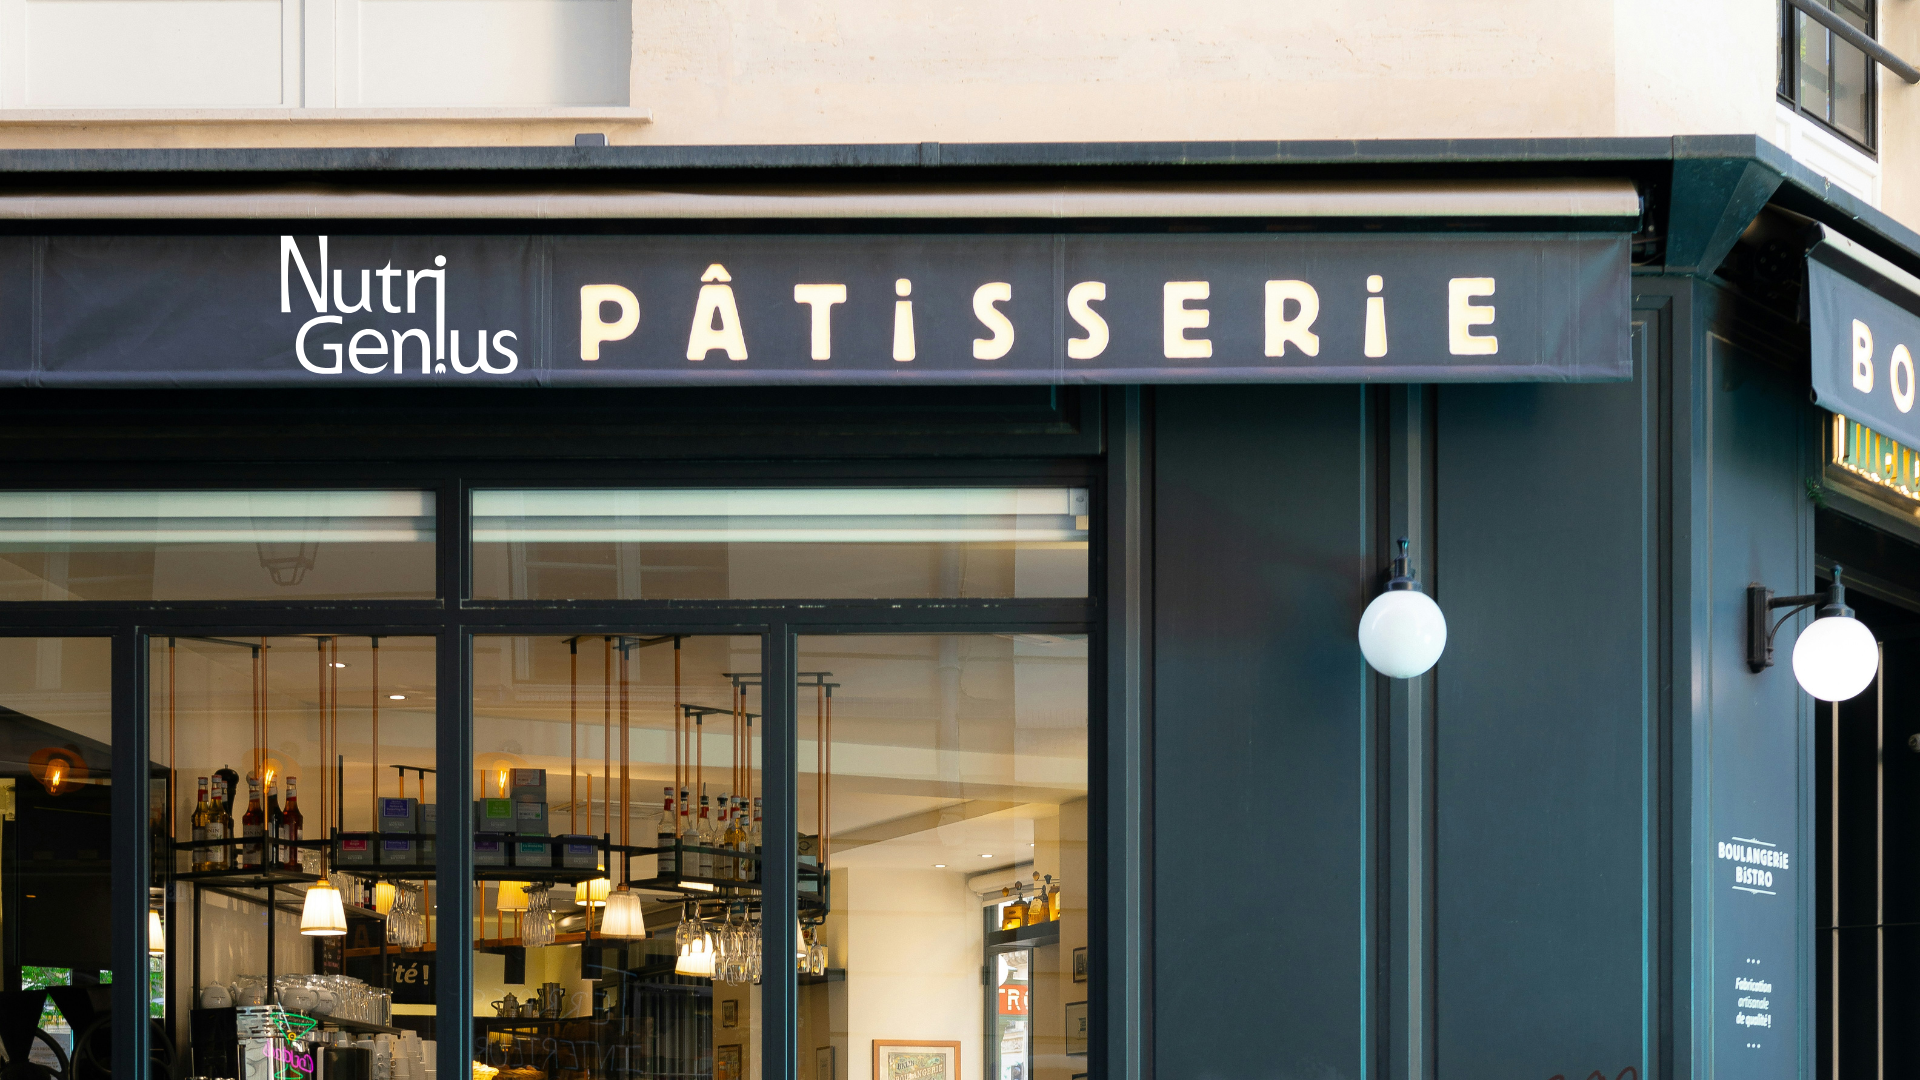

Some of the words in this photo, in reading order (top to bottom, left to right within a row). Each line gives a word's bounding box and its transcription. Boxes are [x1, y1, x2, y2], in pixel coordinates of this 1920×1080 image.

[280, 235, 447, 314] Nutri
[1735, 977, 1772, 993] Fabrication
[1738, 995, 1769, 1010] artisanale
[1735, 1011, 1746, 1025] de
